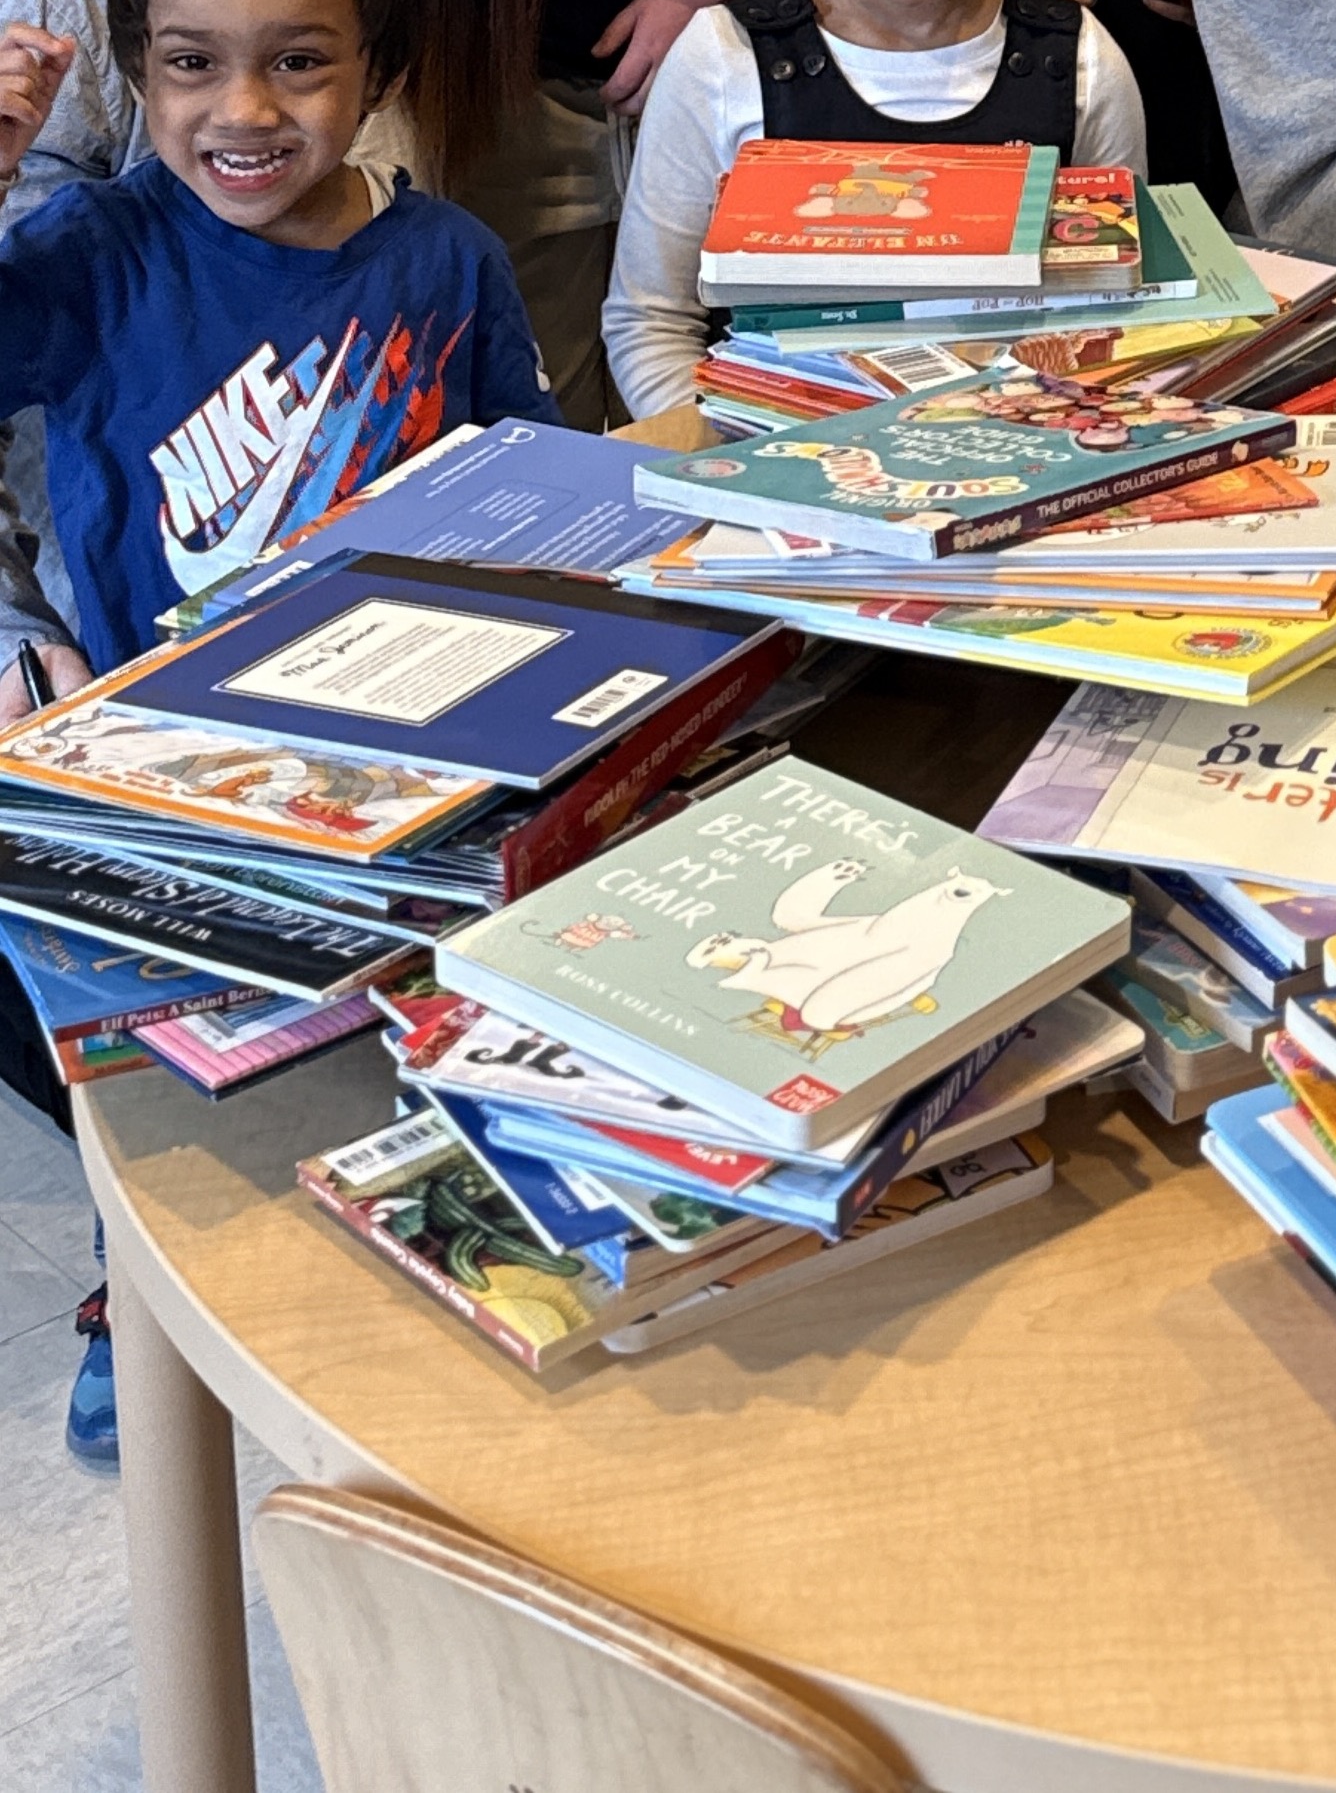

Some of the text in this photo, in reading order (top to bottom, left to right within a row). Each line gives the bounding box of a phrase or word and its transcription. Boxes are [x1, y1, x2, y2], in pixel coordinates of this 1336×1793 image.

[150, 341, 293, 538] NIKE
[891, 436, 1014, 464] OFFICIAL
[954, 424, 1046, 445] GUIDE
[904, 449, 957, 466] THE
[1037, 451, 1219, 519] THE OFFICIAL COLLECTOR'S GUIDE
[630, 756, 651, 786] THE
[1197, 765, 1249, 793] is
[759, 774, 919, 854] THERE'S
[774, 815, 798, 830] A
[696, 812, 813, 872] BEAR
[708, 847, 746, 866] ON
[658, 855, 738, 891] MY
[65, 888, 214, 942] WILL MOSES
[595, 867, 718, 930] CHAIR
[217, 895, 321, 941] Legend
[312, 925, 384, 958] The
[101, 1016, 126, 1033] Elf
[126, 1008, 168, 1028] Pets:
[168, 1002, 181, 1017] A
[182, 992, 225, 1013] Saint
[553, 963, 697, 1038] ROSS COLLINS
